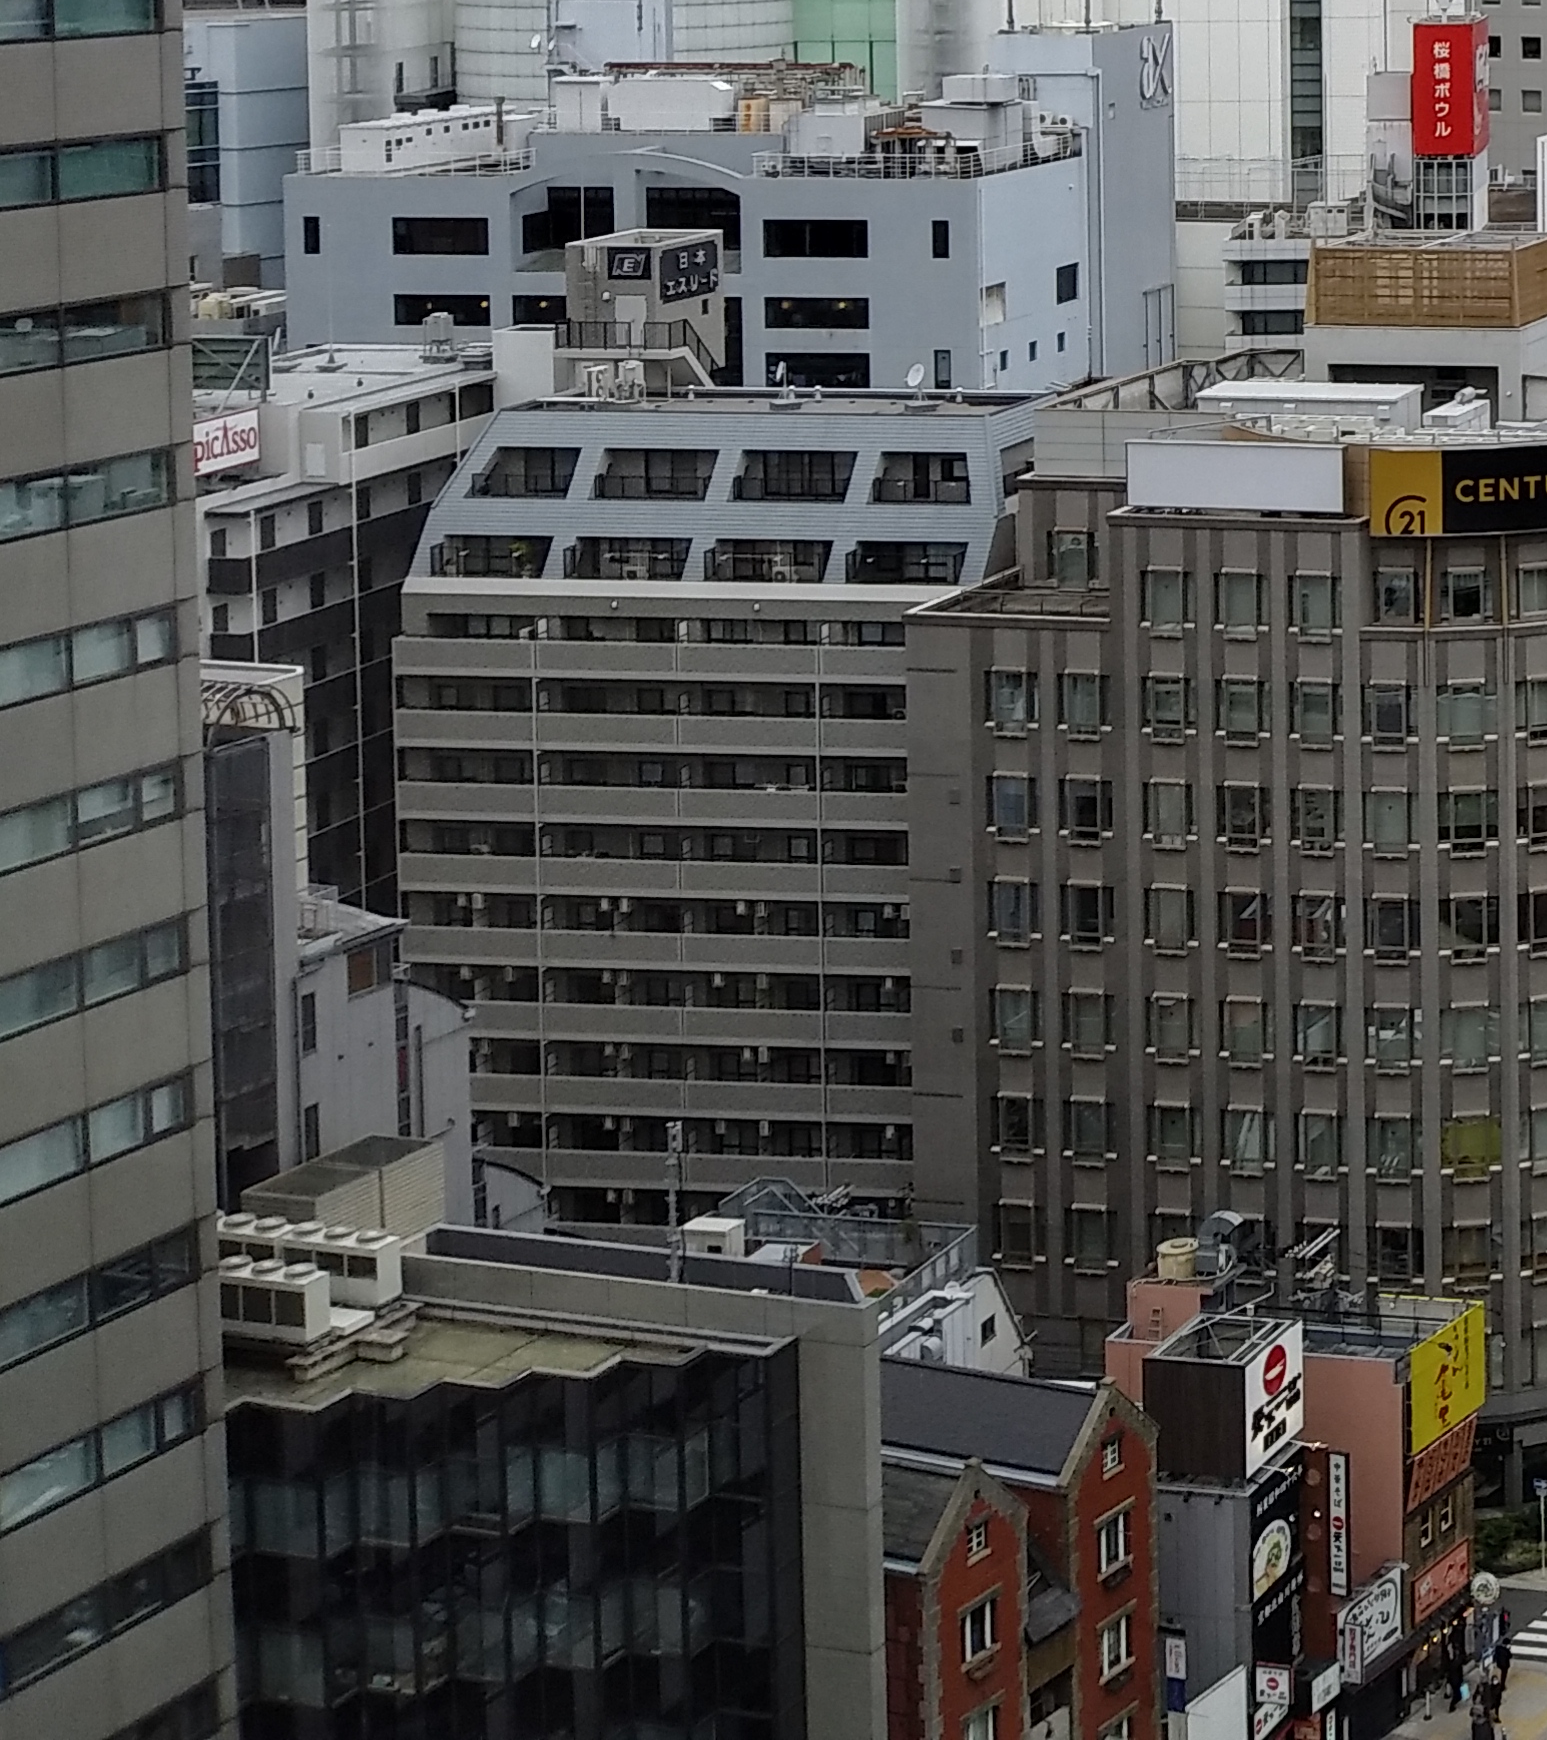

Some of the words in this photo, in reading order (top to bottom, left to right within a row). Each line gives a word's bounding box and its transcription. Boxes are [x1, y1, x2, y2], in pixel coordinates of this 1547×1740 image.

[1432, 41, 1452, 138] 桜橋ボウル
[679, 248, 707, 270] 日本
[665, 268, 719, 296] エスリード
